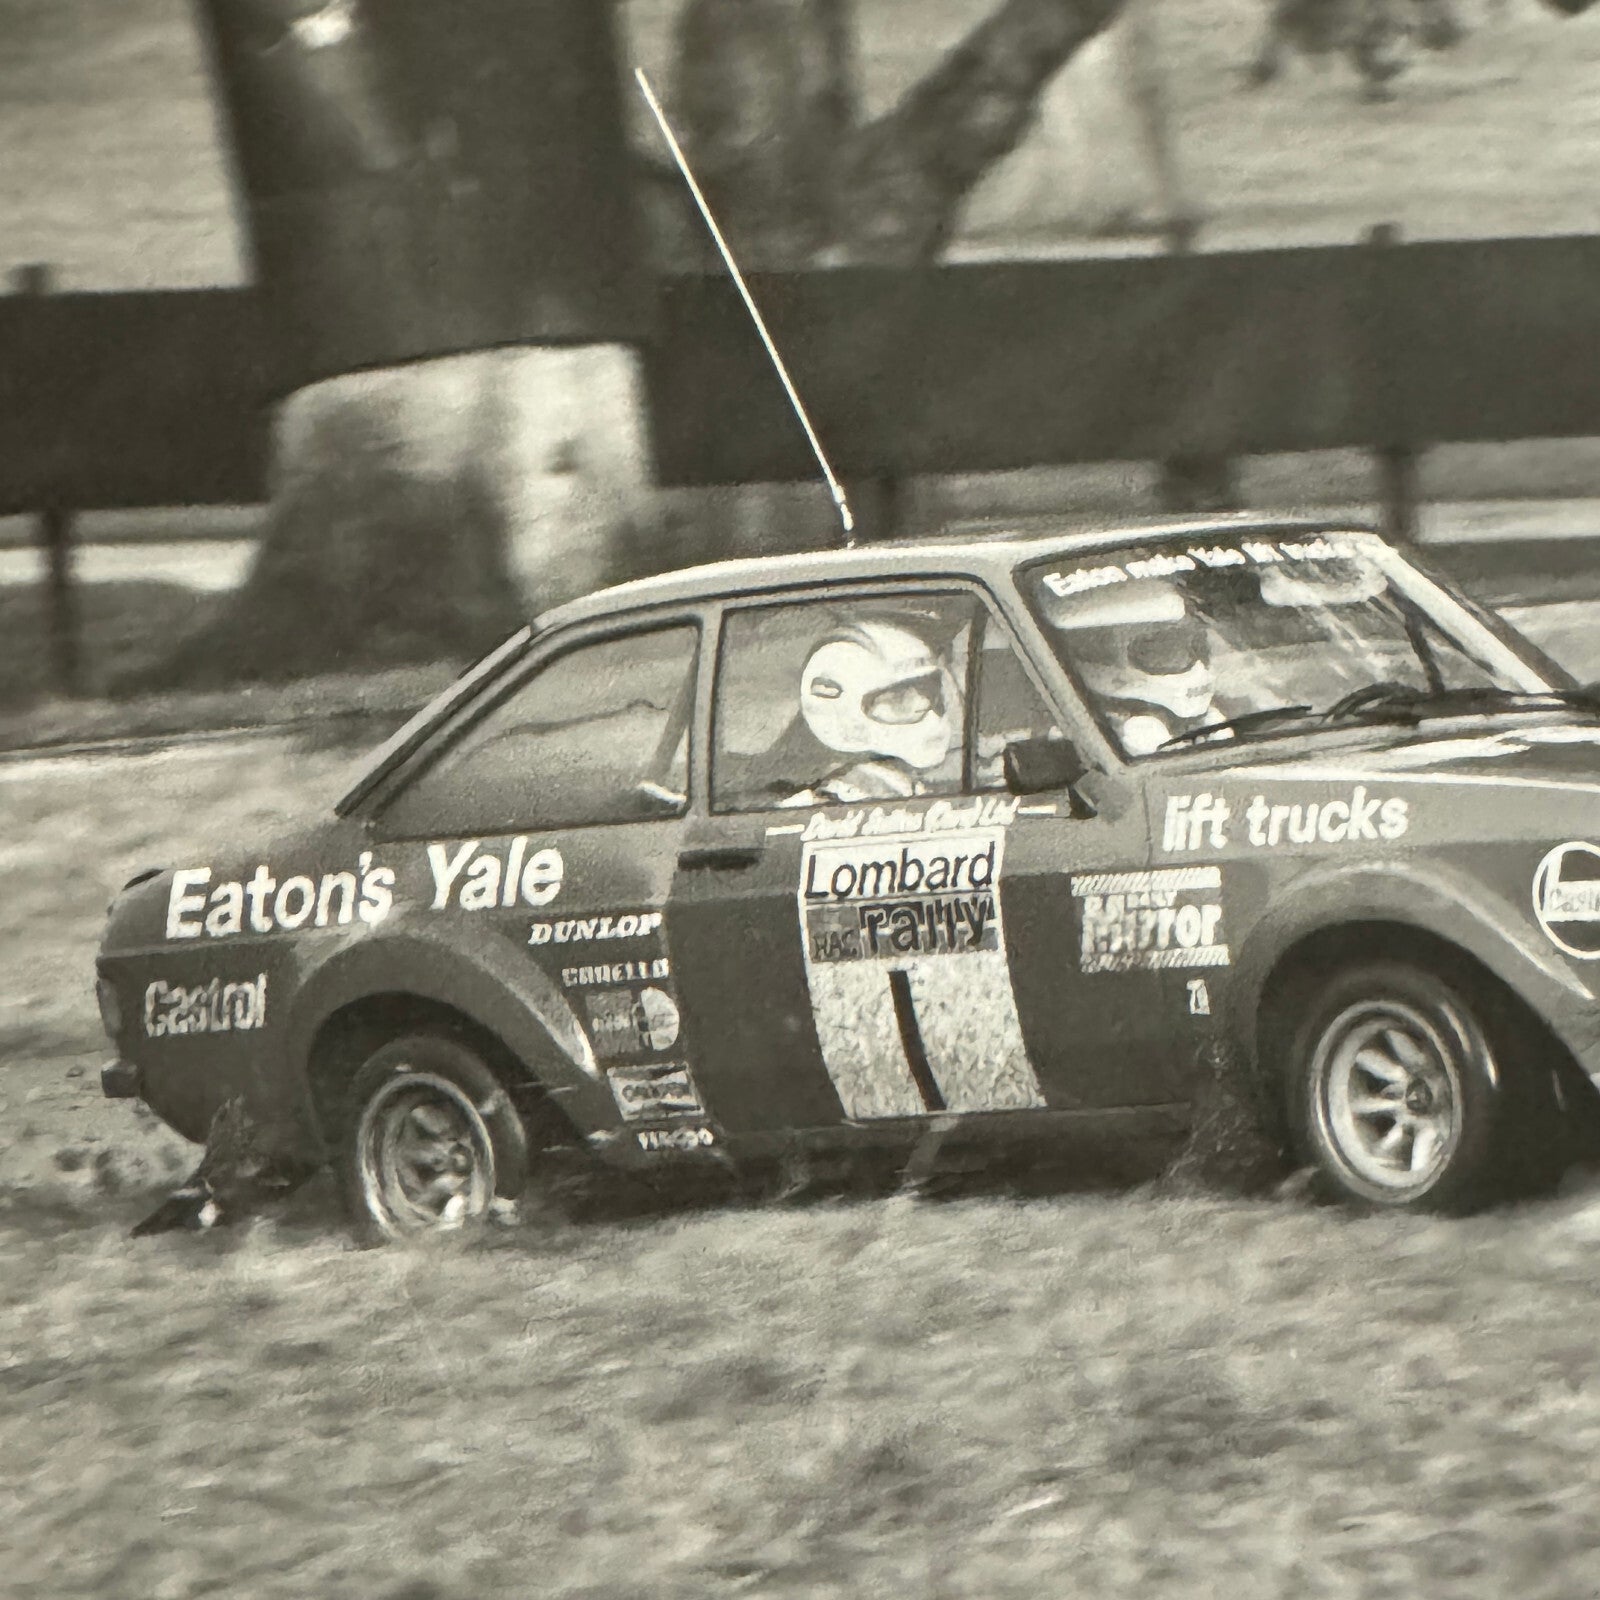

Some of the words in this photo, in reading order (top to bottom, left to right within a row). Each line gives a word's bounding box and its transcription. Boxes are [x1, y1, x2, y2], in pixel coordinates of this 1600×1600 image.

[1163, 793, 1230, 851] lift
[1246, 786, 1409, 846] trucks
[166, 850, 395, 939] Eaton's
[427, 835, 563, 911] Yale
[805, 841, 996, 899] Lombard
[528, 912, 663, 945] DUNLOP
[866, 897, 989, 955] rally
[144, 970, 267, 1037] Castrol
